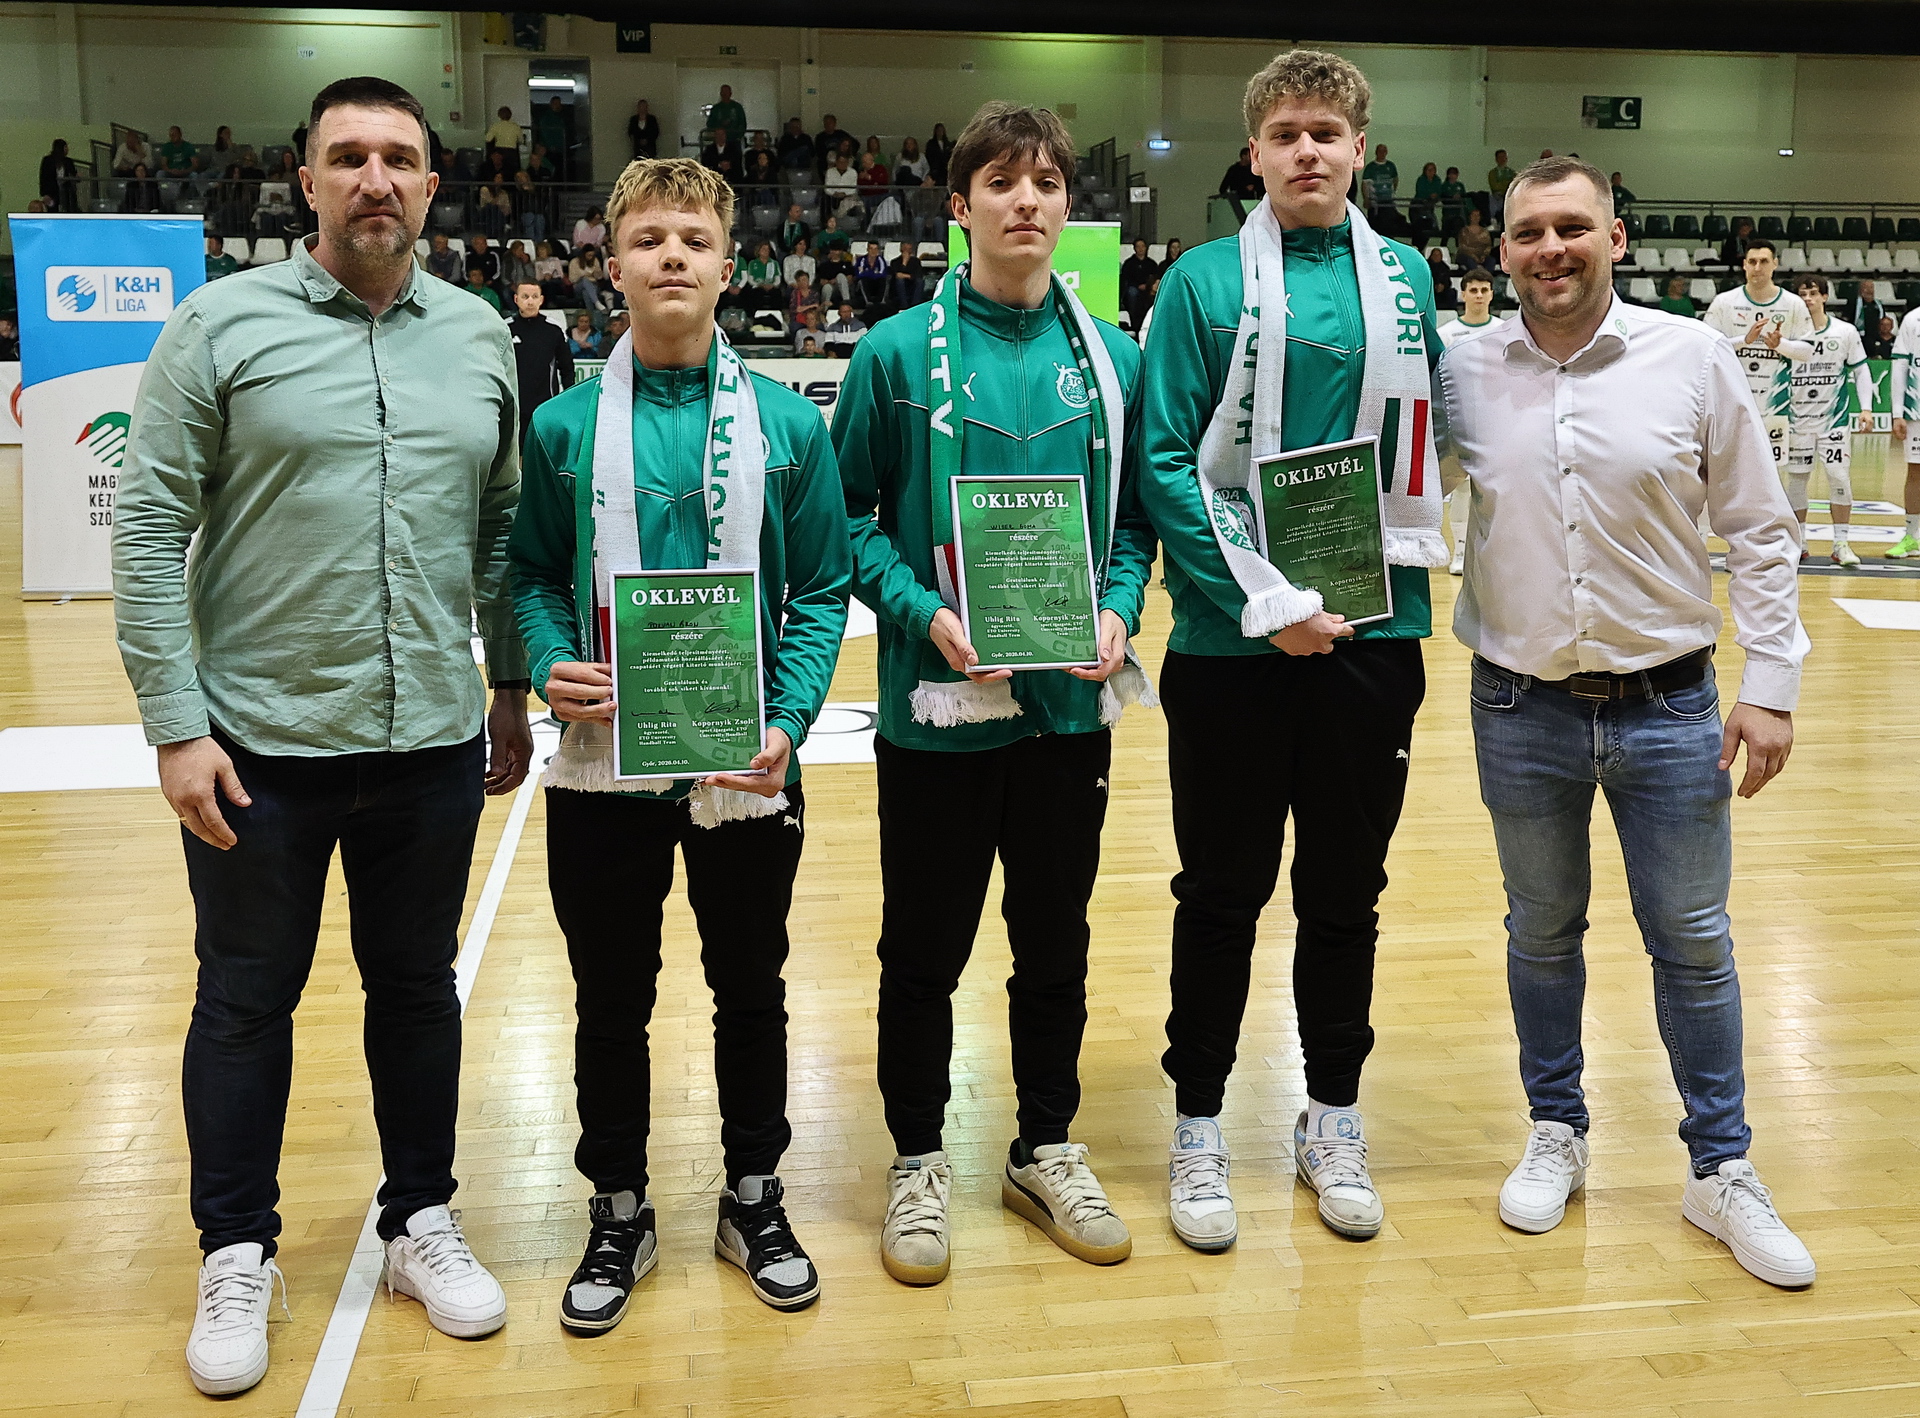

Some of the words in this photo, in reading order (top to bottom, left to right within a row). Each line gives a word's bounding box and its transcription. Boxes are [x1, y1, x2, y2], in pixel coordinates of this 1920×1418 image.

[622, 30, 645, 41] VIP
[299, 50, 313, 58] VIP
[1619, 98, 1634, 120] C
[115, 276, 160, 293] K&H
[116, 298, 146, 312] LIGA
[1826, 449, 1843, 463] 24
[1273, 456, 1364, 488] OKLEVÉL
[971, 490, 1069, 509] OKLEVÉL
[1307, 503, 1335, 514] részére
[1009, 533, 1039, 541] részére
[1330, 575, 1362, 587] Kopornyik
[631, 584, 741, 606] OKLEVÉL
[1033, 614, 1069, 622] Kopornyik
[671, 632, 704, 640] részére
[642, 656, 680, 664] példamutató
[629, 663, 661, 671] csapatáért
[692, 720, 732, 728] Kopornyik
